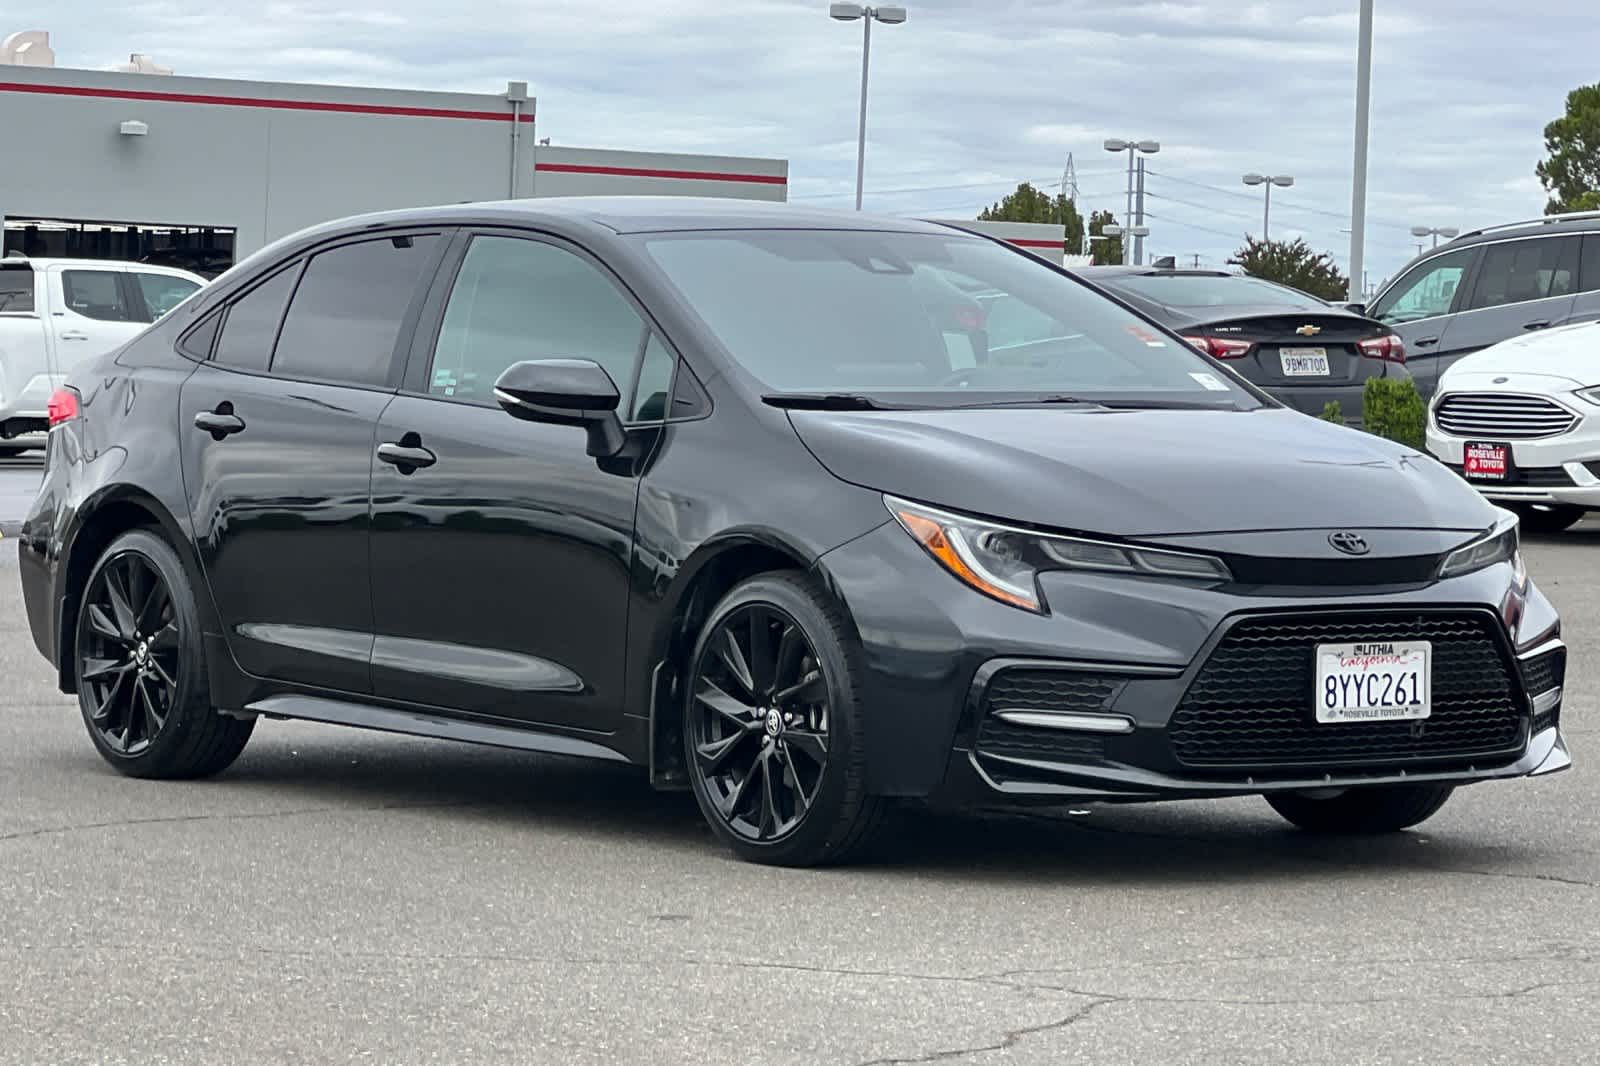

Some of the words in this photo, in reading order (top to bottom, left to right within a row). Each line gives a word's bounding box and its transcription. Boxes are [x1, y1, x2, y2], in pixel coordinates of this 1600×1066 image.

[1468, 449, 1504, 460] ROSEVILLE
[1479, 459, 1504, 470] TOYOTA
[1363, 644, 1394, 656] LITHIA
[1325, 672, 1421, 708] 8YYC261
[1343, 709, 1379, 718] ROSEVILLE
[1380, 707, 1405, 716] TOYOTA
